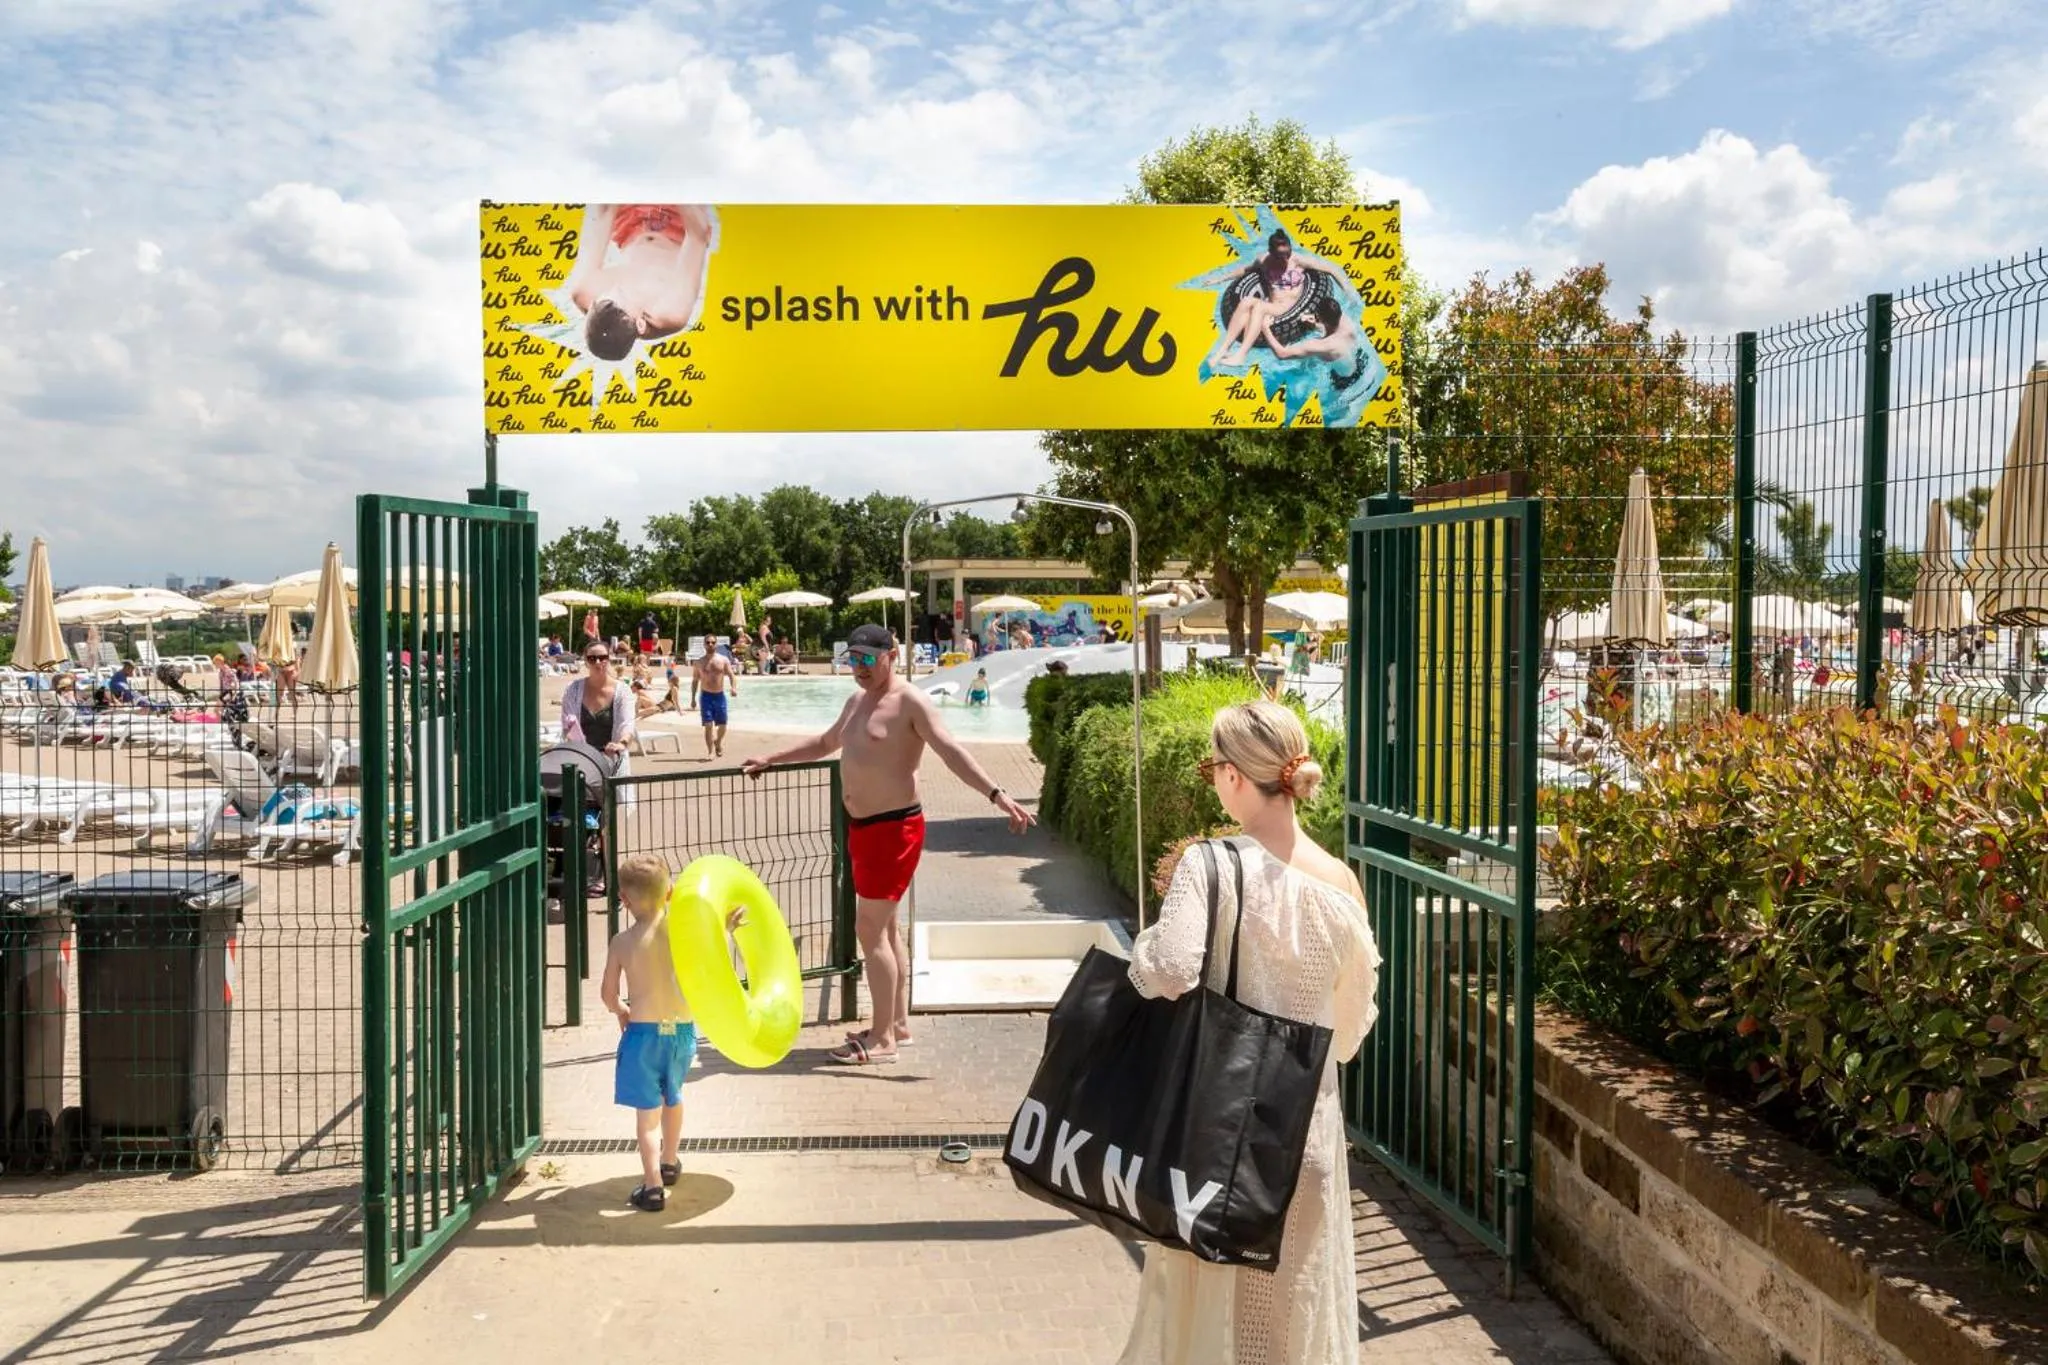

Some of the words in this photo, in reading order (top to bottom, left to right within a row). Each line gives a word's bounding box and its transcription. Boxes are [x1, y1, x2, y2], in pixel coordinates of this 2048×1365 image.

[492, 215, 520, 233] hu
[535, 213, 563, 231] hu
[1208, 217, 1235, 234] hu
[1295, 217, 1322, 234] hu
[1335, 214, 1362, 232] hu
[508, 235, 543, 257] hu
[549, 230, 579, 260] h
[1310, 236, 1343, 256] hu
[1349, 230, 1395, 260] hu
[493, 265, 521, 283] hu
[536, 263, 565, 281] hu
[510, 285, 544, 306] hu
[722, 285, 859, 331] splash
[873, 285, 969, 321] with
[982, 256, 1178, 378] hu
[510, 335, 545, 355] hu
[496, 364, 524, 381] hu
[679, 363, 706, 381] hu
[512, 384, 545, 404] hu
[605, 384, 637, 404] hu
[644, 378, 692, 407] hu
[1225, 380, 1257, 400] hu
[496, 414, 525, 431] hu
[539, 411, 567, 429] hu
[589, 413, 616, 430] hu
[631, 410, 659, 428] hu
[1210, 408, 1237, 425] hu
[1250, 406, 1277, 423] hu
[1296, 408, 1322, 425] hu
[1010, 1097, 1225, 1247] DKNY
